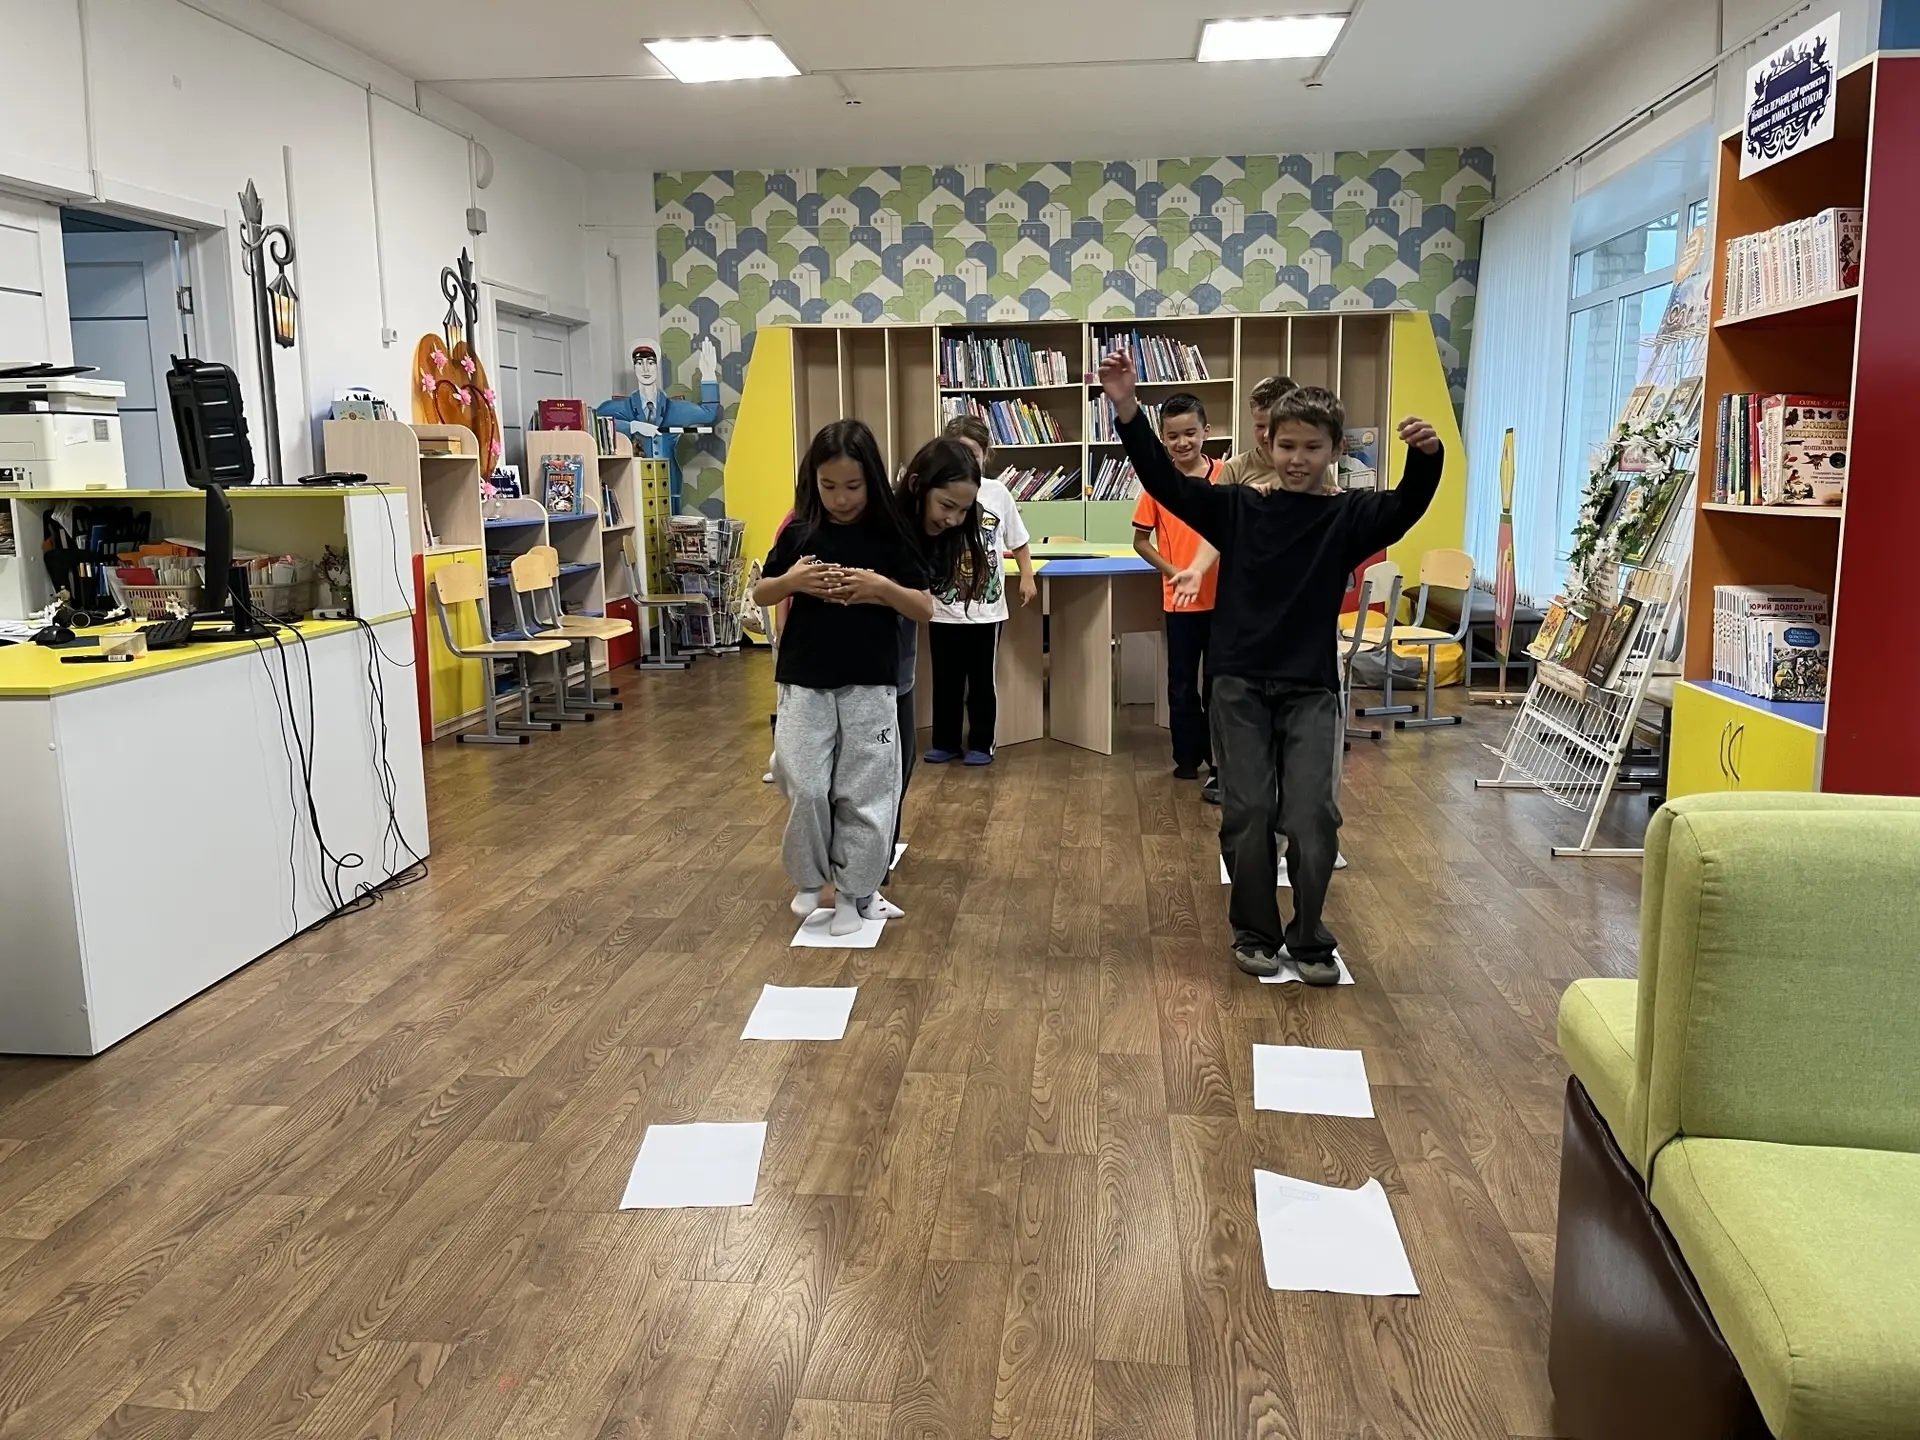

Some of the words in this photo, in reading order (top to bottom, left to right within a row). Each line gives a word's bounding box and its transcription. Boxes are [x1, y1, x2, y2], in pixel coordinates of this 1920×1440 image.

[1771, 106, 1790, 124] ЮНЫХ
[1791, 88, 1823, 114] ЗНАТОКОВ
[1749, 602, 1772, 611] ЮРИЙ
[1774, 603, 1824, 612] ДОЛГОРУКИЙ
